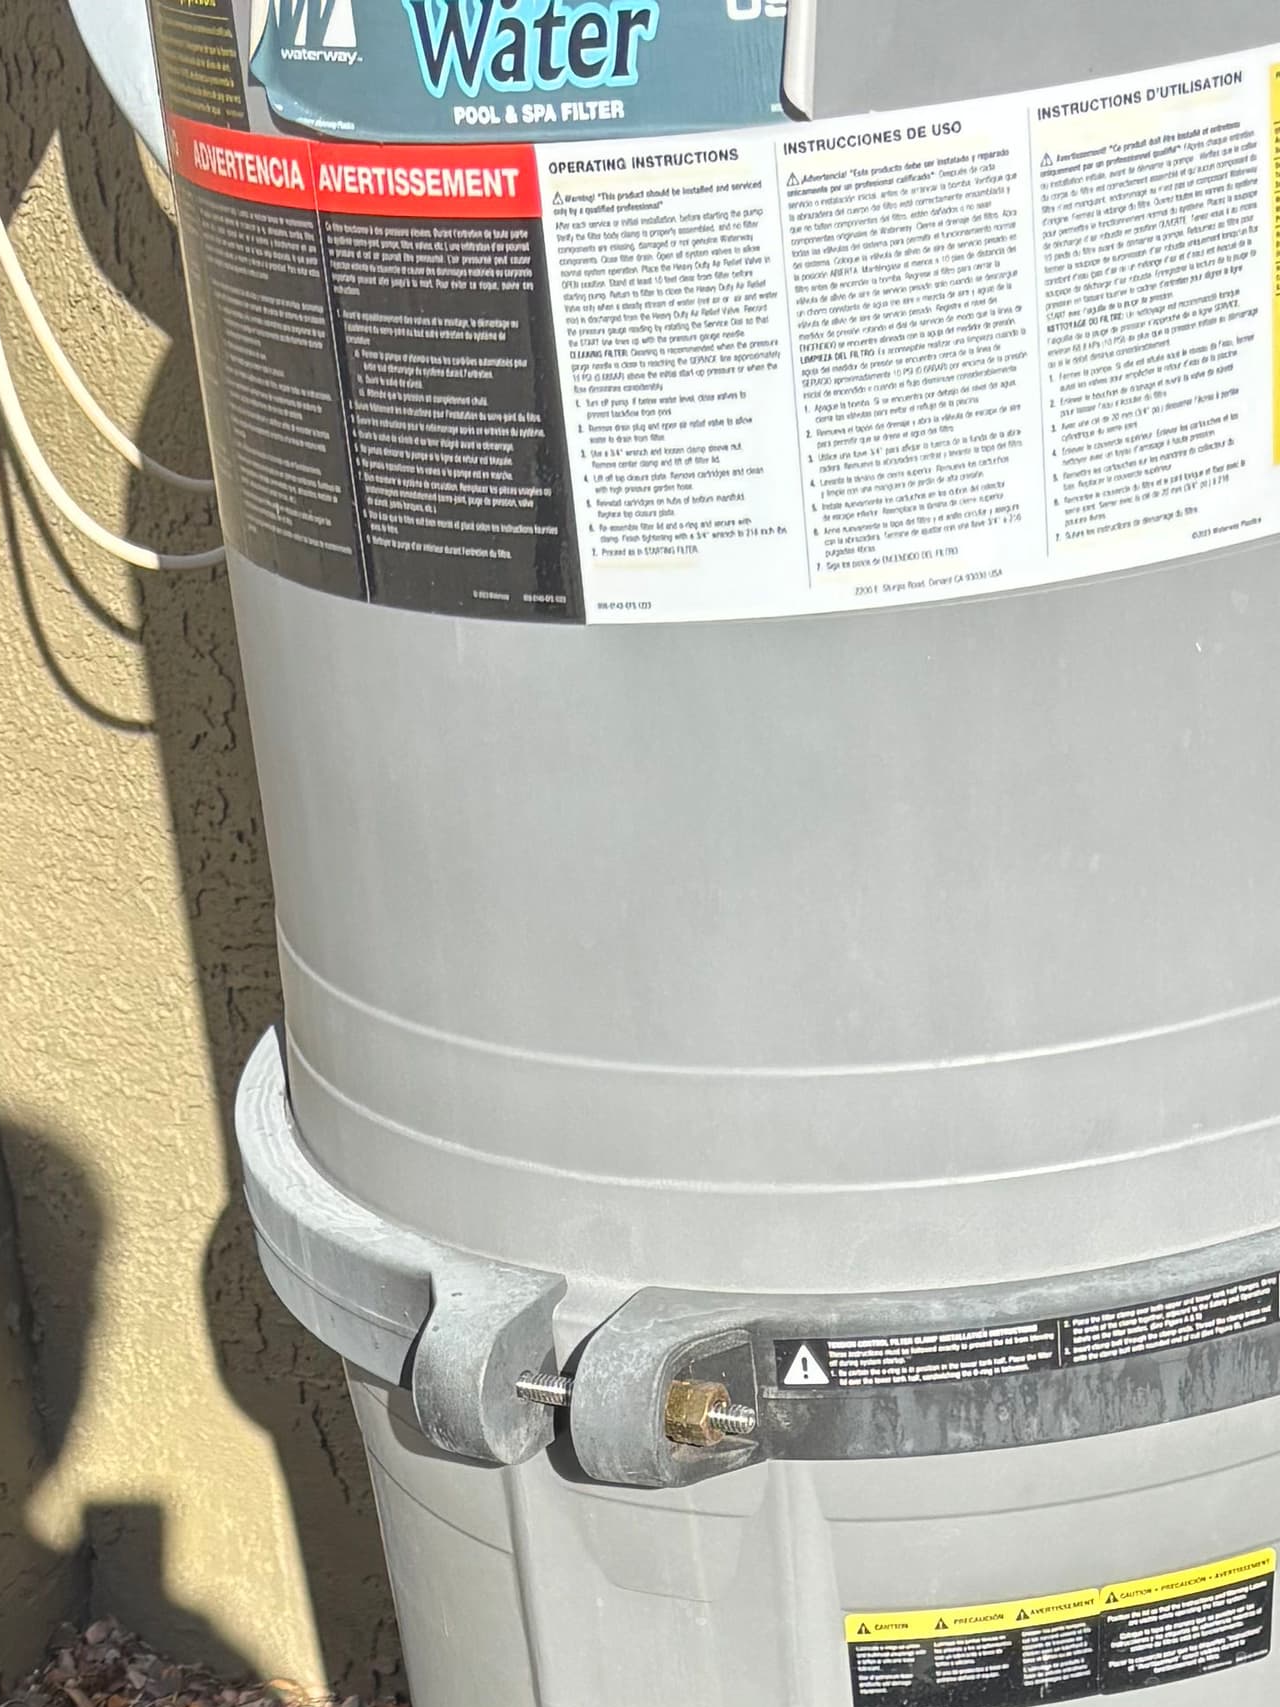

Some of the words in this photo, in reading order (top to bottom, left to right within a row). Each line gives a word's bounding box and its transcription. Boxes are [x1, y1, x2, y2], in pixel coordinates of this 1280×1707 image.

[280, 48, 357, 65] waterway
[404, 0, 658, 95] Water
[1037, 90, 1141, 121] INSTRUCTIONS
[1146, 71, 1243, 102] D'UTILISATION
[453, 106, 501, 125] POOL
[505, 105, 518, 123] &
[522, 104, 556, 124] SPA
[561, 100, 625, 122] FILTER
[783, 129, 902, 156] INSTRUCCIONES
[907, 126, 926, 140] DE
[932, 121, 962, 136] USO
[1124, 139, 1146, 151] produit
[192, 139, 306, 192] ADVERTENCIA
[549, 157, 626, 175] OPERATING
[632, 148, 739, 169] INSTRUCTIONS
[871, 164, 902, 176] producto
[904, 162, 921, 172] debe
[937, 155, 969, 167] instalado
[977, 148, 1009, 161] reparado
[318, 165, 520, 199] AVERTISSEMENT
[617, 190, 644, 201] product
[646, 187, 670, 197] should
[672, 187, 681, 196] be
[682, 185, 714, 195] installed
[716, 183, 729, 193] and
[731, 180, 762, 191] serviced
[855, 177, 894, 191] profesional
[585, 202, 615, 216] qualified
[680, 212, 701, 222] before
[703, 210, 728, 222] starting
[730, 208, 742, 218] the
[604, 229, 619, 240] body
[719, 222, 731, 232] and
[720, 233, 753, 245] Waterway
[1120, 1588, 1152, 1599] CAUTION
[1214, 1558, 1270, 1579] AVERTISSEMENT
[1030, 1598, 1095, 1615] AVERTISSEMENT
